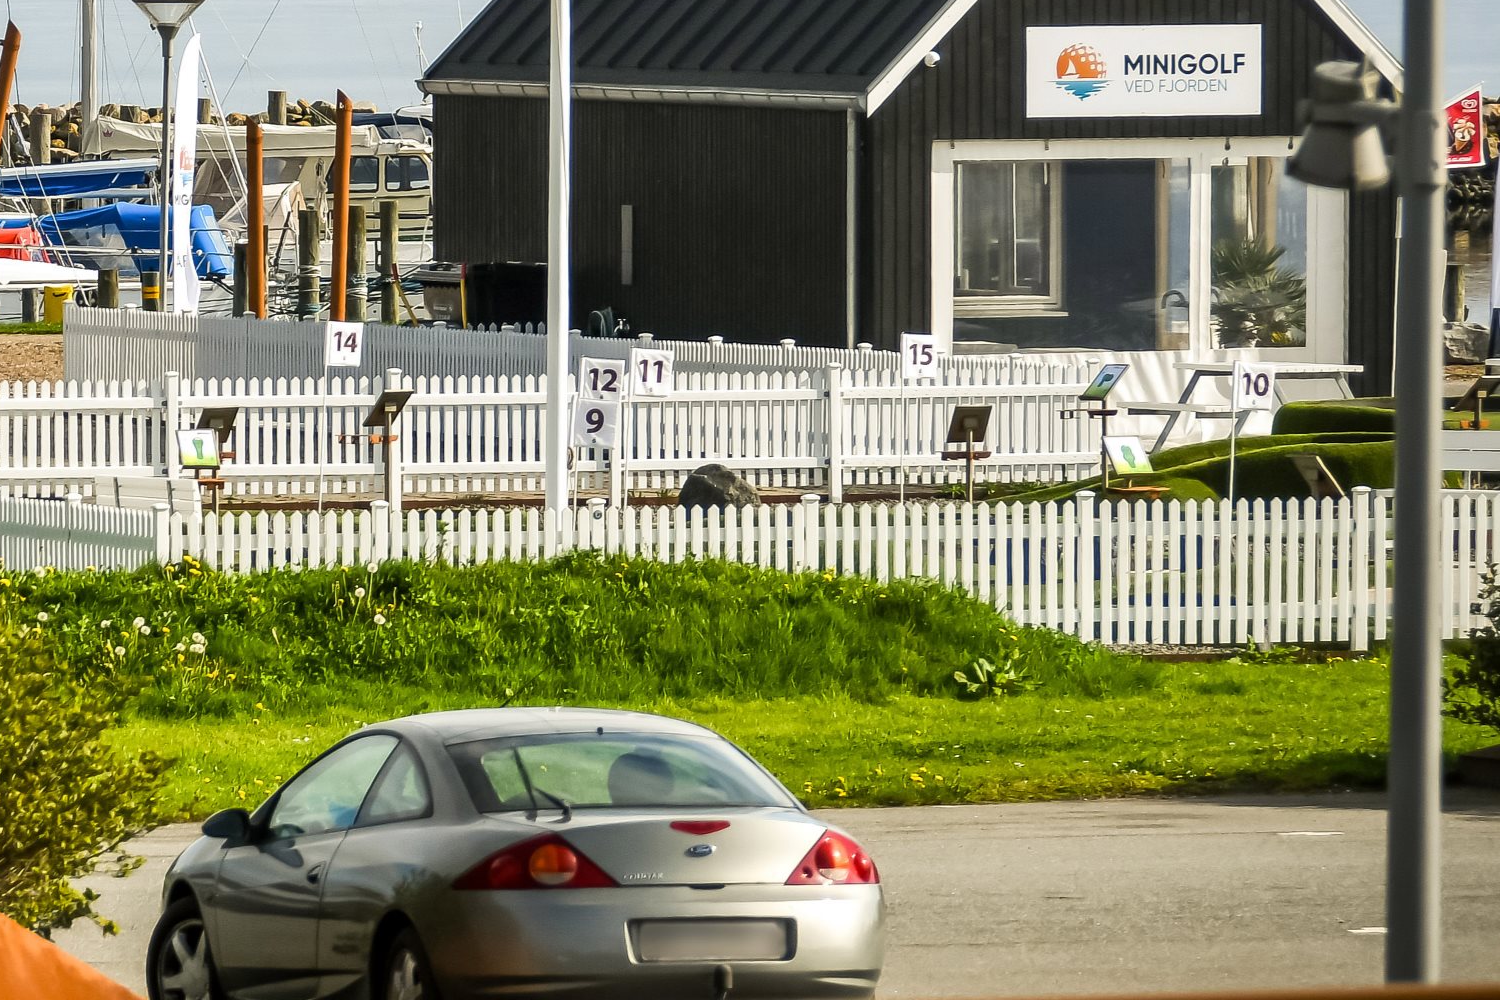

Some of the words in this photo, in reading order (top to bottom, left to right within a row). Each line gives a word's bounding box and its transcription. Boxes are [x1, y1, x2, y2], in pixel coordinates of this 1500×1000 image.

[1123, 53, 1246, 76] MINIGOLF
[1124, 79, 1154, 93] VED
[1158, 78, 1228, 93] FJORDEN
[333, 331, 358, 353] 14
[909, 343, 933, 366] 15
[588, 367, 618, 393] 12
[638, 359, 664, 384] 11
[1242, 372, 1270, 397] 10
[585, 407, 605, 434] 9
